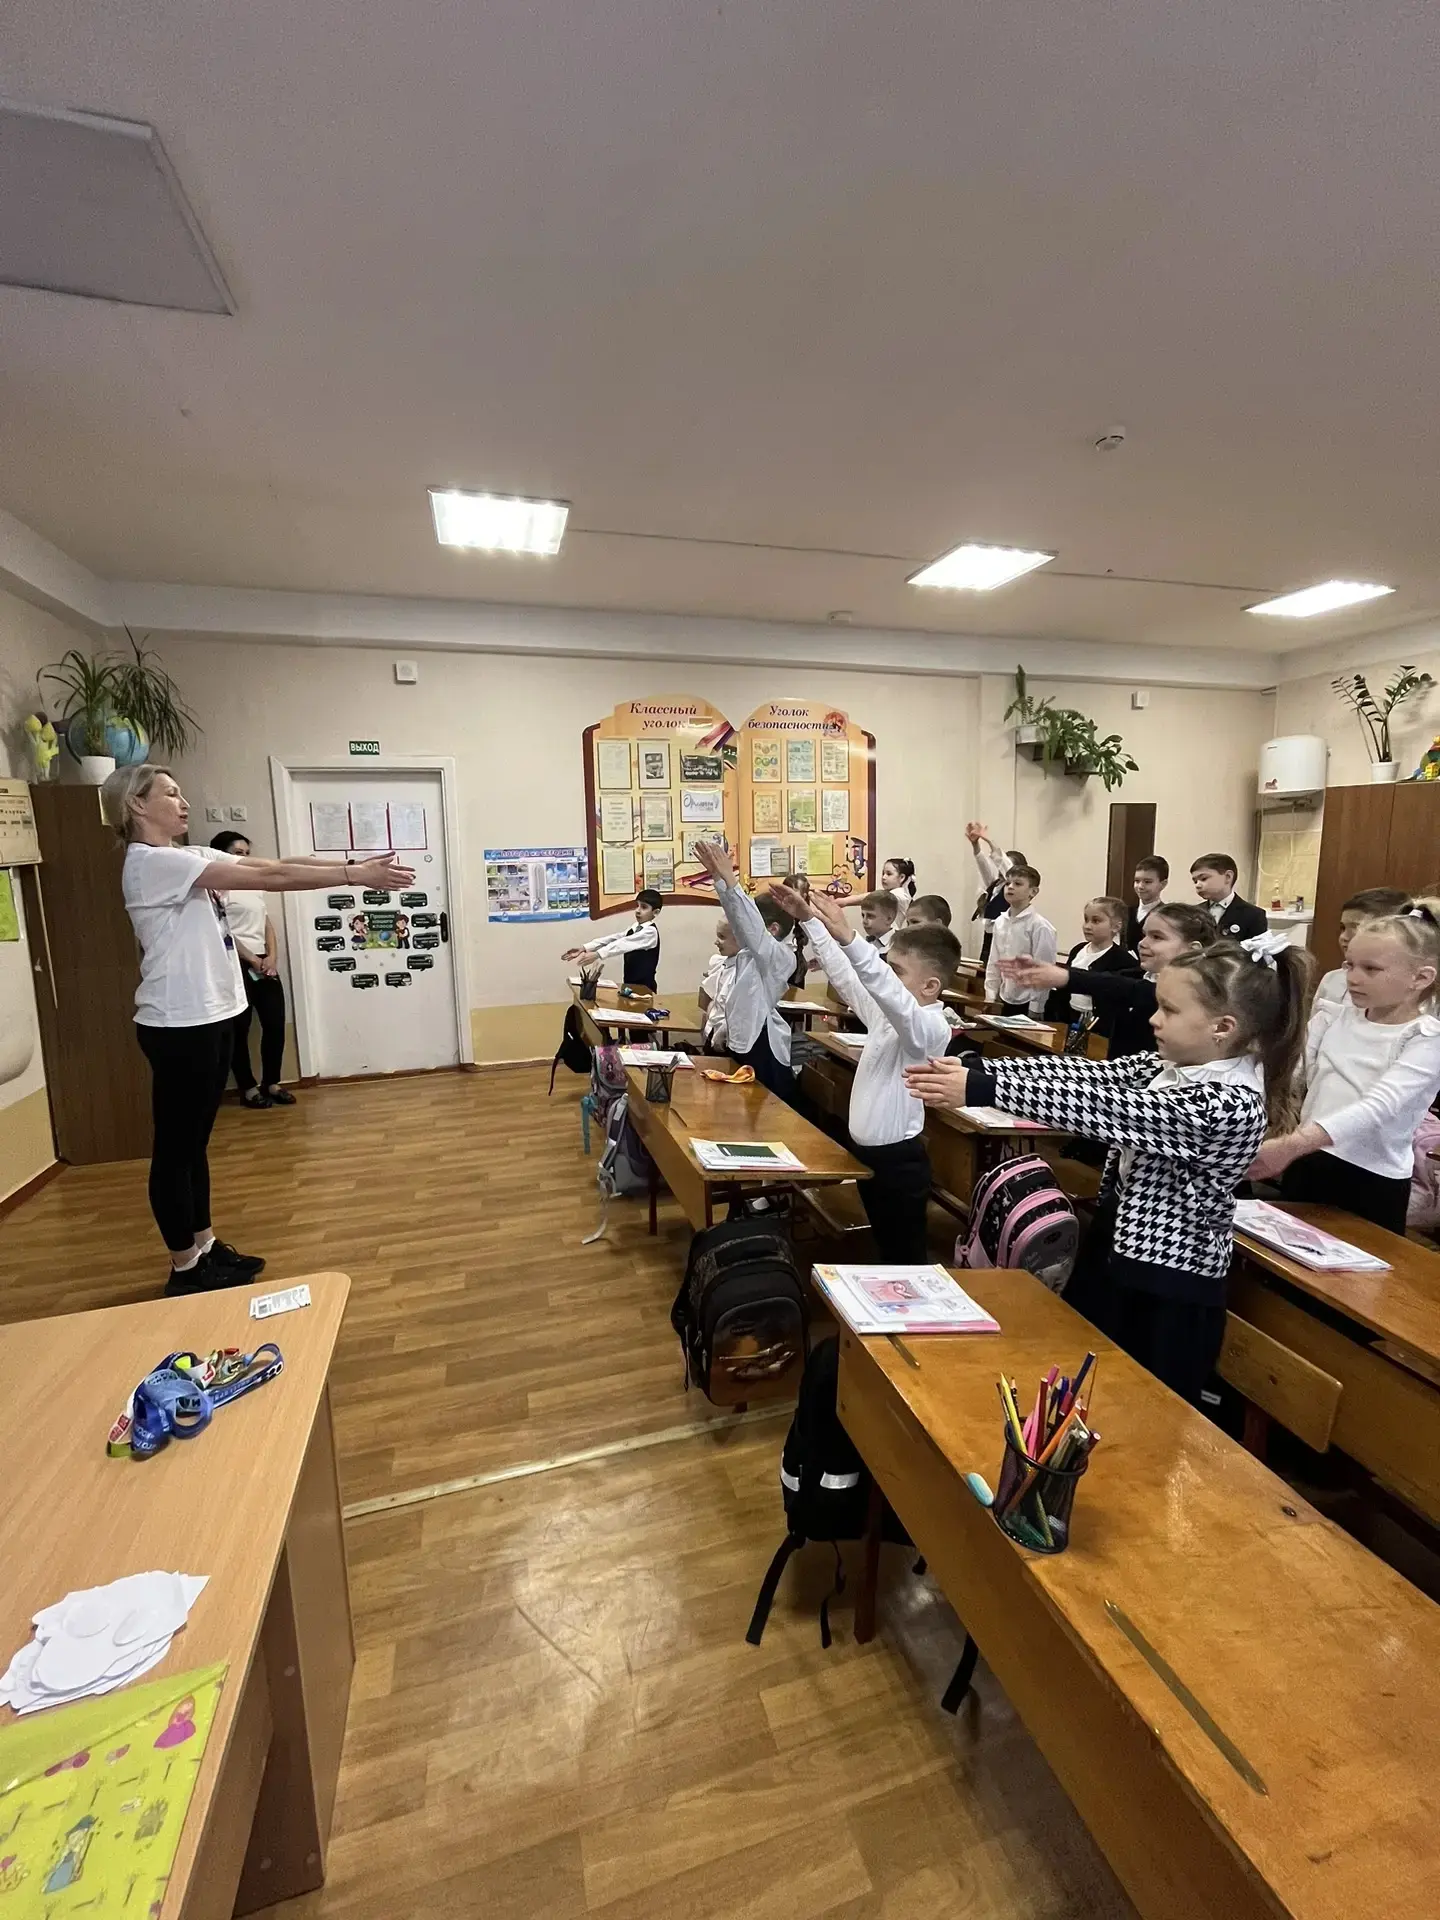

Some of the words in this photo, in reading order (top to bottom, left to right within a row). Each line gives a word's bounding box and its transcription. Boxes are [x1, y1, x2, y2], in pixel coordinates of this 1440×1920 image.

[630, 702, 697, 715] Классный
[769, 705, 809, 717] Уголок
[350, 743, 379, 753] ВЫХОД
